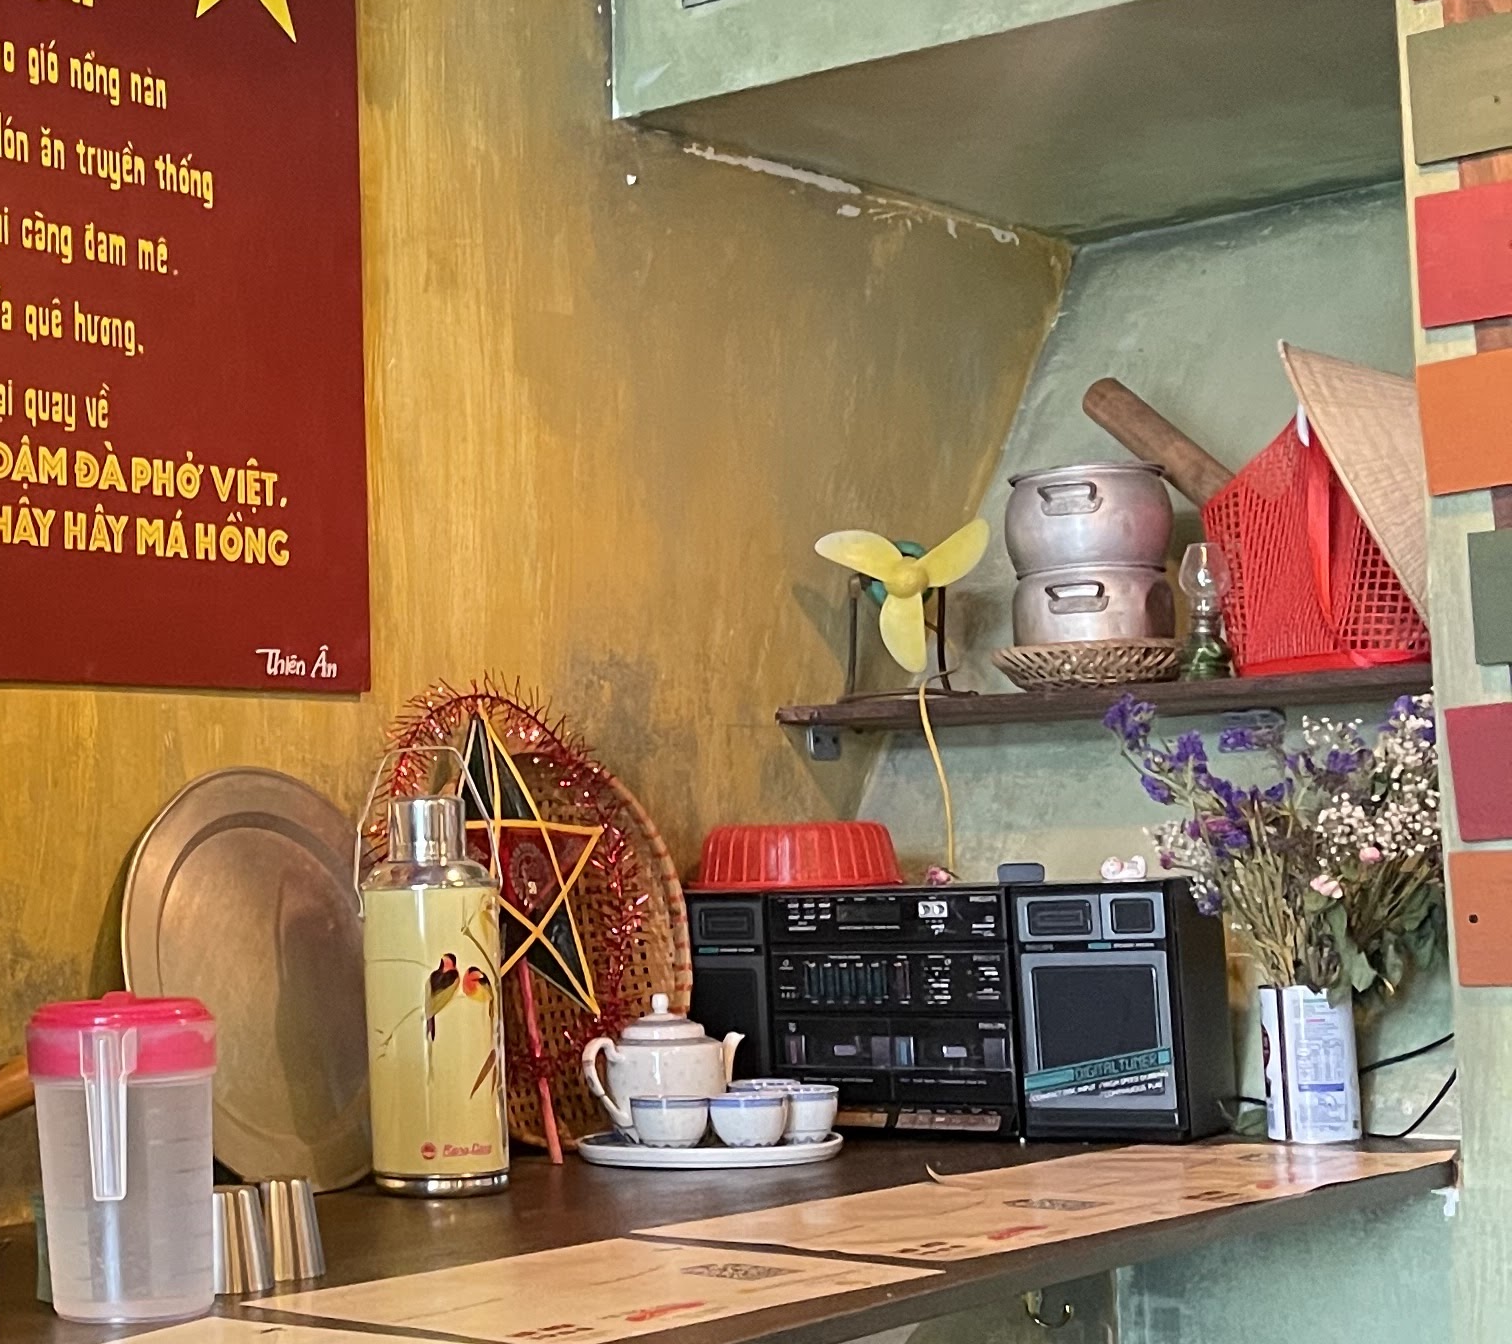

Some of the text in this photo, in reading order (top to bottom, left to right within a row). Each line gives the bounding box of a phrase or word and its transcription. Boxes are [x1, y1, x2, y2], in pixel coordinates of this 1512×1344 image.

[28, 40, 58, 85] gió
[130, 67, 167, 109] nàn
[41, 126, 65, 170] ăn
[76, 141, 146, 190] truyền
[155, 153, 214, 209] thống
[21, 210, 73, 264] càng
[85, 222, 126, 266] đam
[25, 297, 63, 341] quê
[24, 387, 76, 432] quay
[85, 382, 110, 429] về
[74, 440, 128, 492] ĐÀ
[131, 450, 204, 499] PHỞ
[64, 503, 129, 553] HÂY
[136, 509, 189, 559] MÁ
[195, 511, 290, 566] HỒNG
[310, 644, 337, 678] Ân
